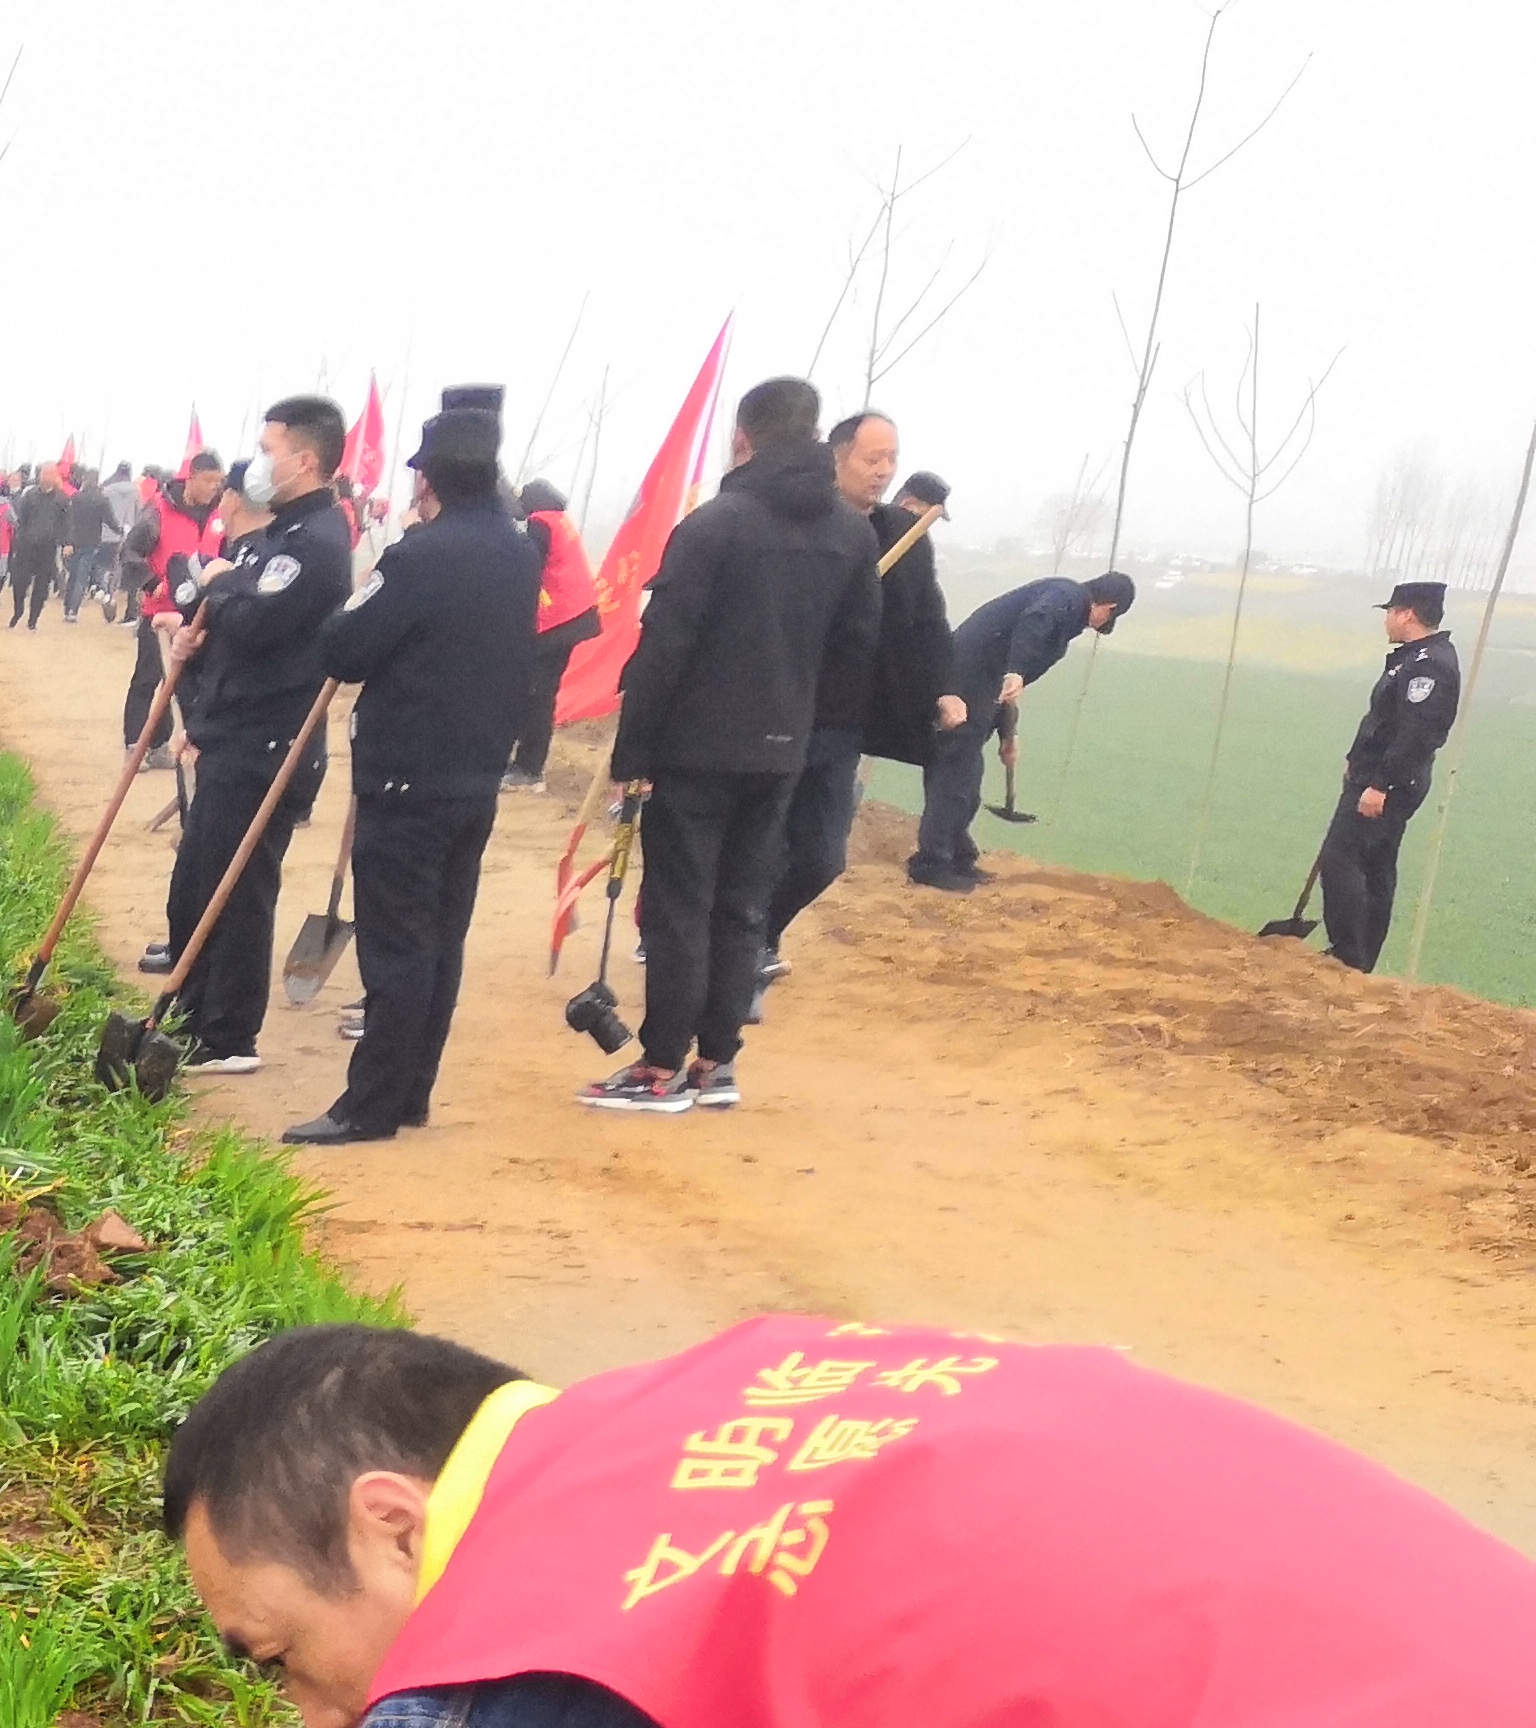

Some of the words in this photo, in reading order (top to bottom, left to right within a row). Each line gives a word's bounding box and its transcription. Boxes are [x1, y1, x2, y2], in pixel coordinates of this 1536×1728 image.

[620, 1321, 892, 1611] 文明临
[718, 1331, 1006, 1597] 志愿先
